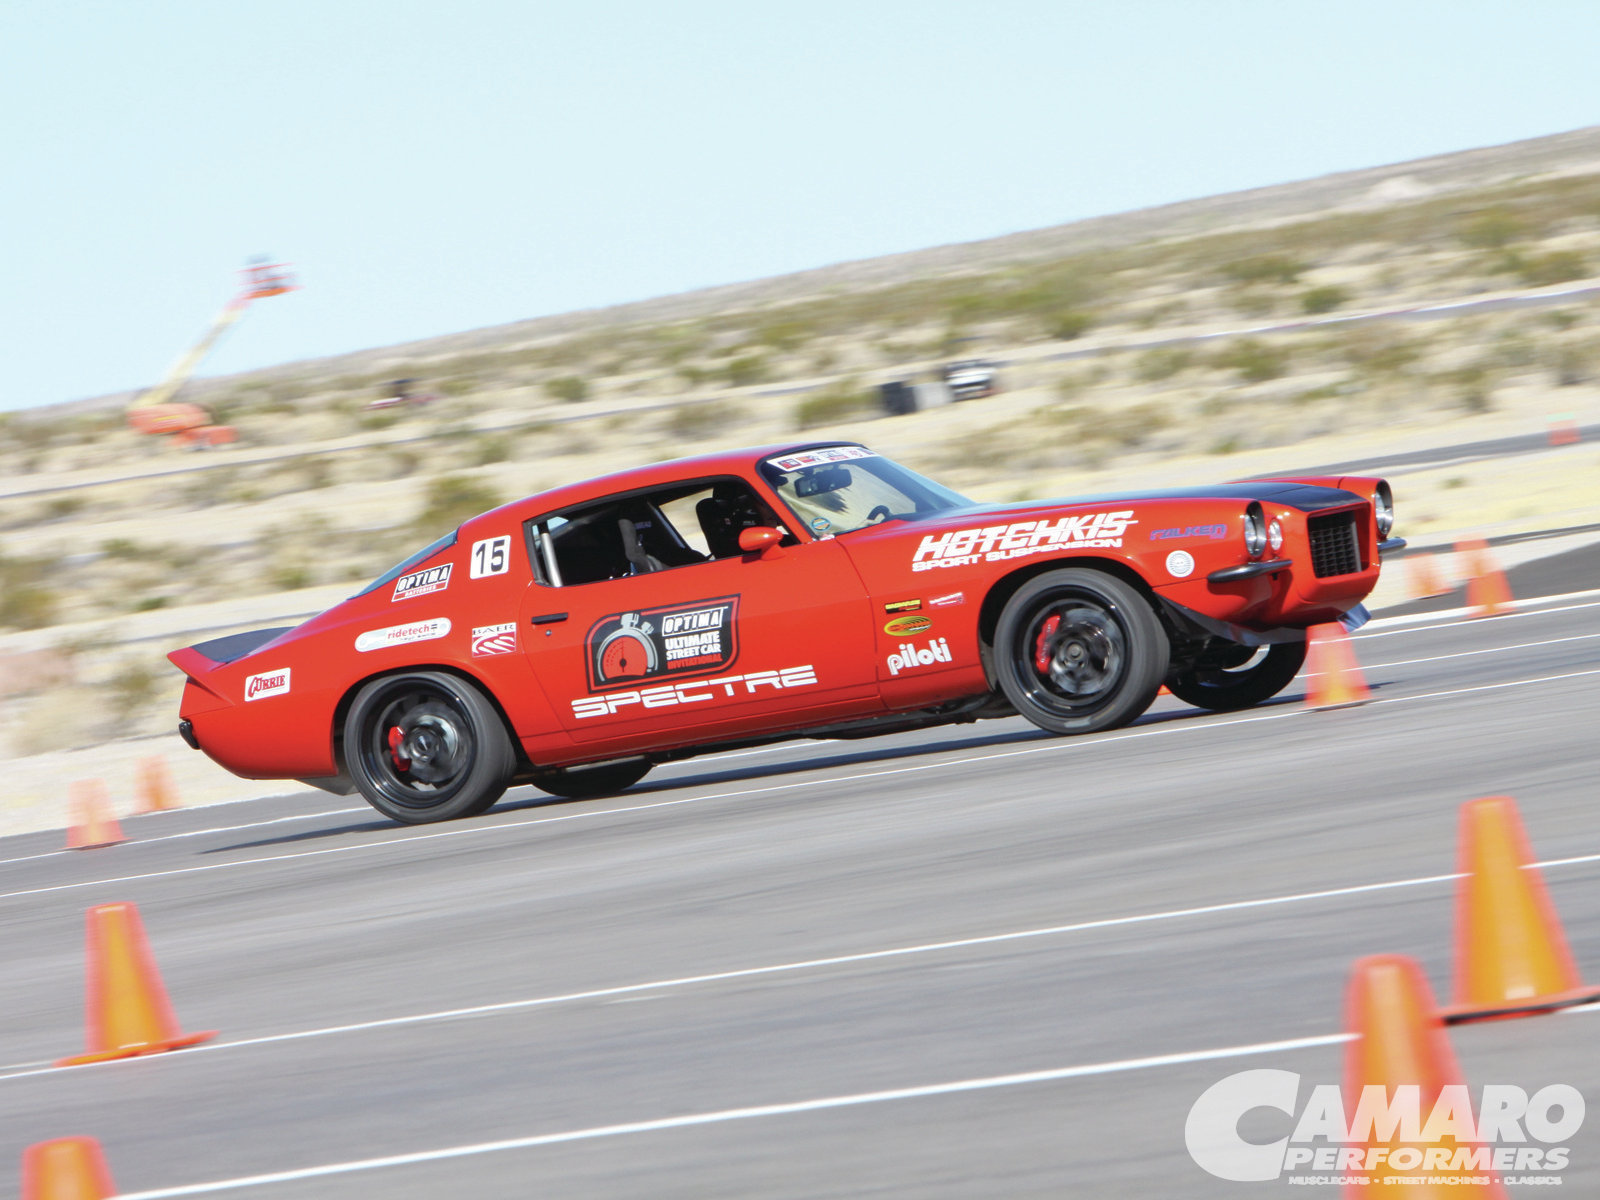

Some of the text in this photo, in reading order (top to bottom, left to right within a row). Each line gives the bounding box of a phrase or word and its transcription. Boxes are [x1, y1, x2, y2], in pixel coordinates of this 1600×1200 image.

[912, 510, 1139, 562] HOTCHKIS
[1150, 524, 1227, 541] FALKEN
[475, 539, 505, 575] 15
[912, 538, 1122, 572] SPORT SUSPENSION
[396, 565, 450, 592] OPTIMA
[472, 624, 514, 636] BAER
[664, 611, 720, 633] OPTIMA
[665, 631, 721, 650] ULTIMATE
[666, 643, 722, 661] STREET CAR
[887, 637, 953, 676] piloti
[247, 674, 286, 698] CURRIE
[571, 664, 818, 719] SPECTRE
